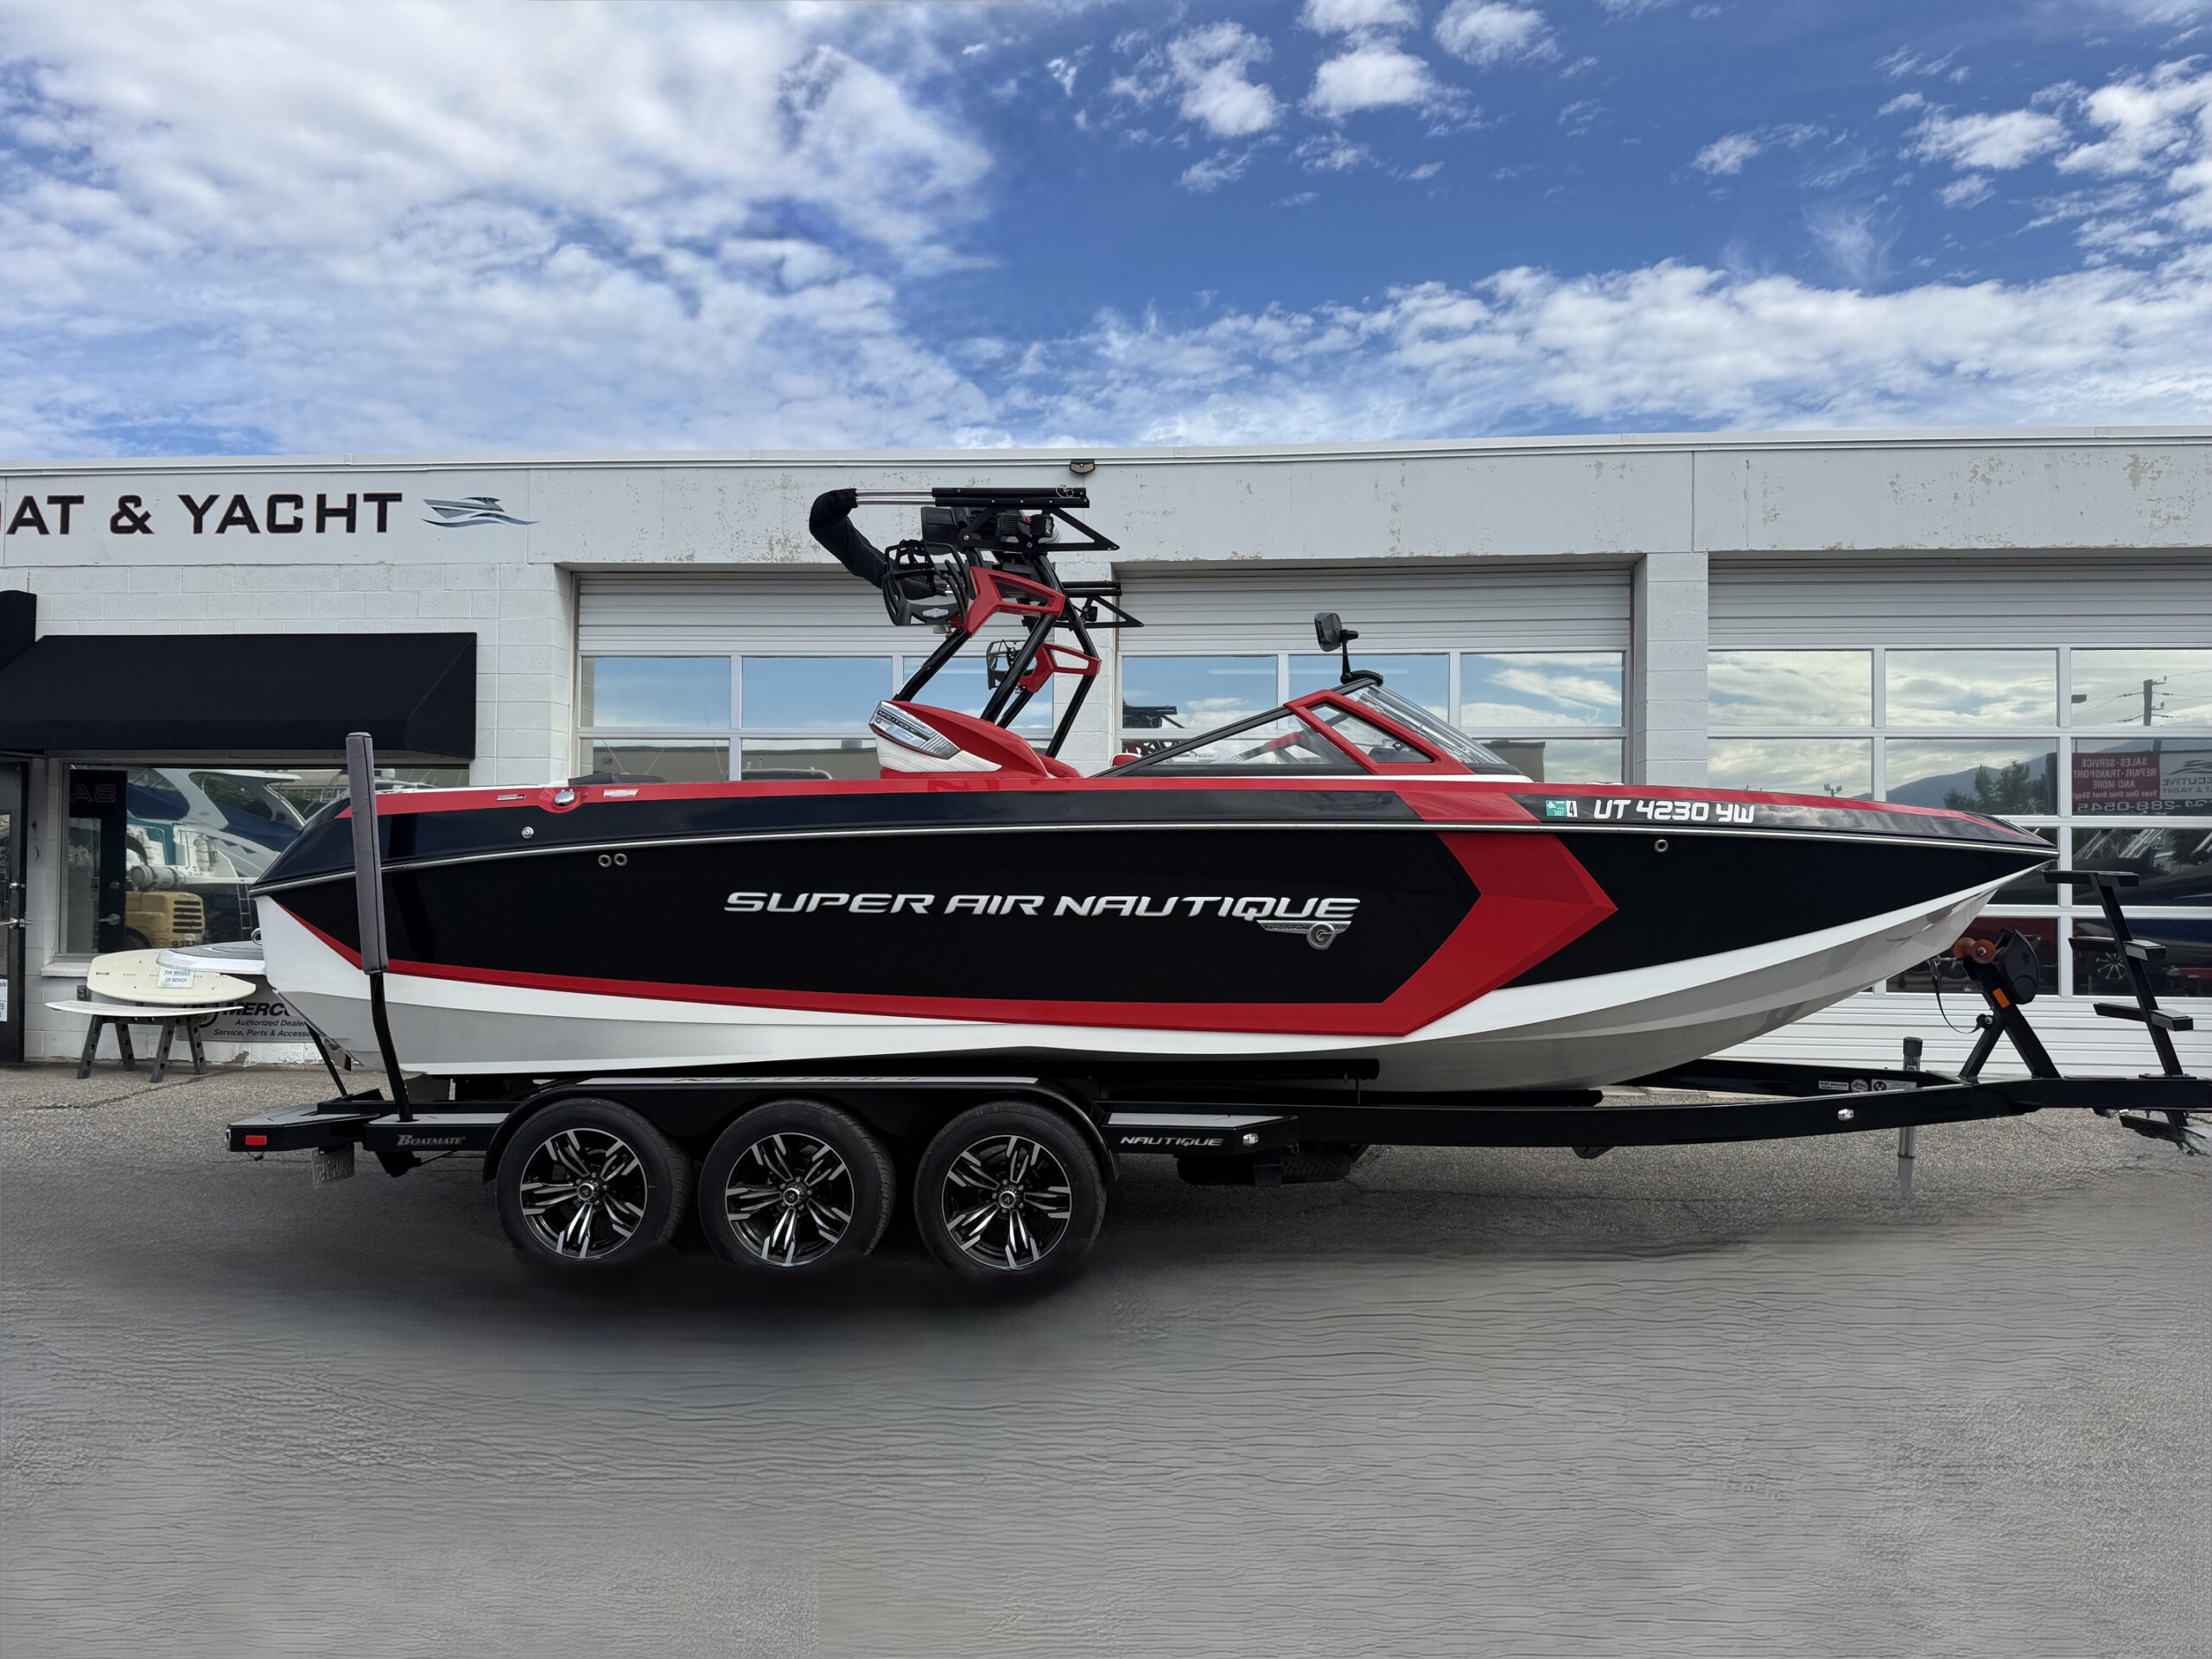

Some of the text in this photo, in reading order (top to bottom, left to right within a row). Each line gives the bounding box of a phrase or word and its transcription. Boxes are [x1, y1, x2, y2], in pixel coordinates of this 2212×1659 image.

[0, 493, 403, 535] AT & YACHT
[1593, 799, 1755, 823] UT 4230 YW
[724, 892, 1360, 922] SUPER AIR NAUTIQUE
[222, 1002, 290, 1017] MERC
[235, 1018, 307, 1027] Authorized Dealer
[213, 1028, 245, 1037] Service,
[246, 1028, 269, 1037] Parts
[1120, 1135, 1224, 1147] NAUTIQUE
